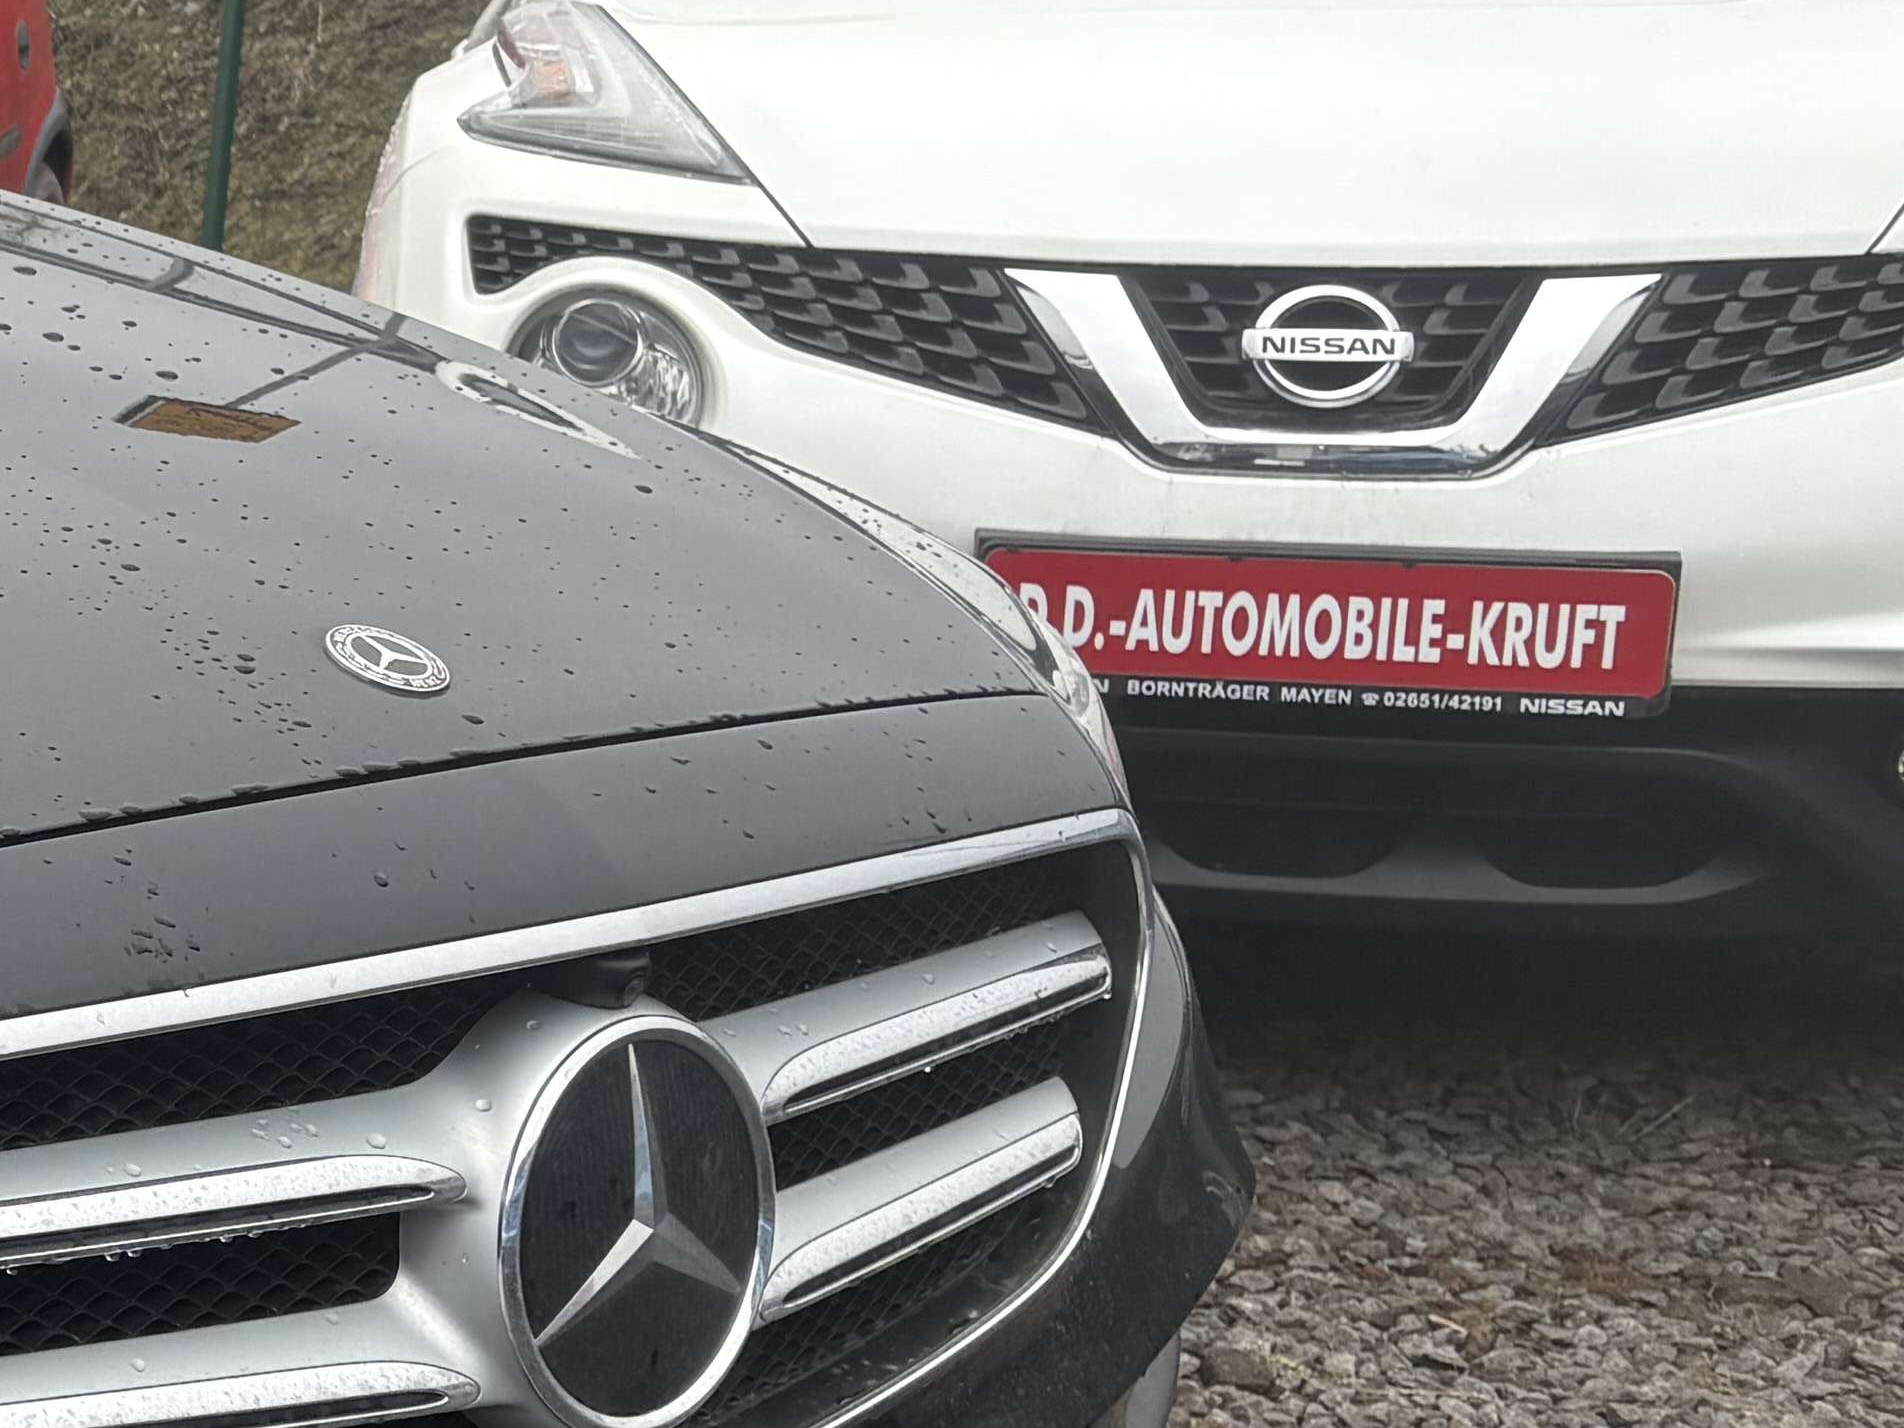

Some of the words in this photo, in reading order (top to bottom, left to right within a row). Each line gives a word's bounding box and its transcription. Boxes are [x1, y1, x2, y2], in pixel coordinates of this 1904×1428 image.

[1261, 336, 1396, 355] NISSAN
[1127, 678, 1269, 701] BORNTRÄGER
[1280, 686, 1352, 706] MAYEN
[1383, 694, 1502, 712] 02651/42191
[1519, 697, 1625, 717] NISSAN
